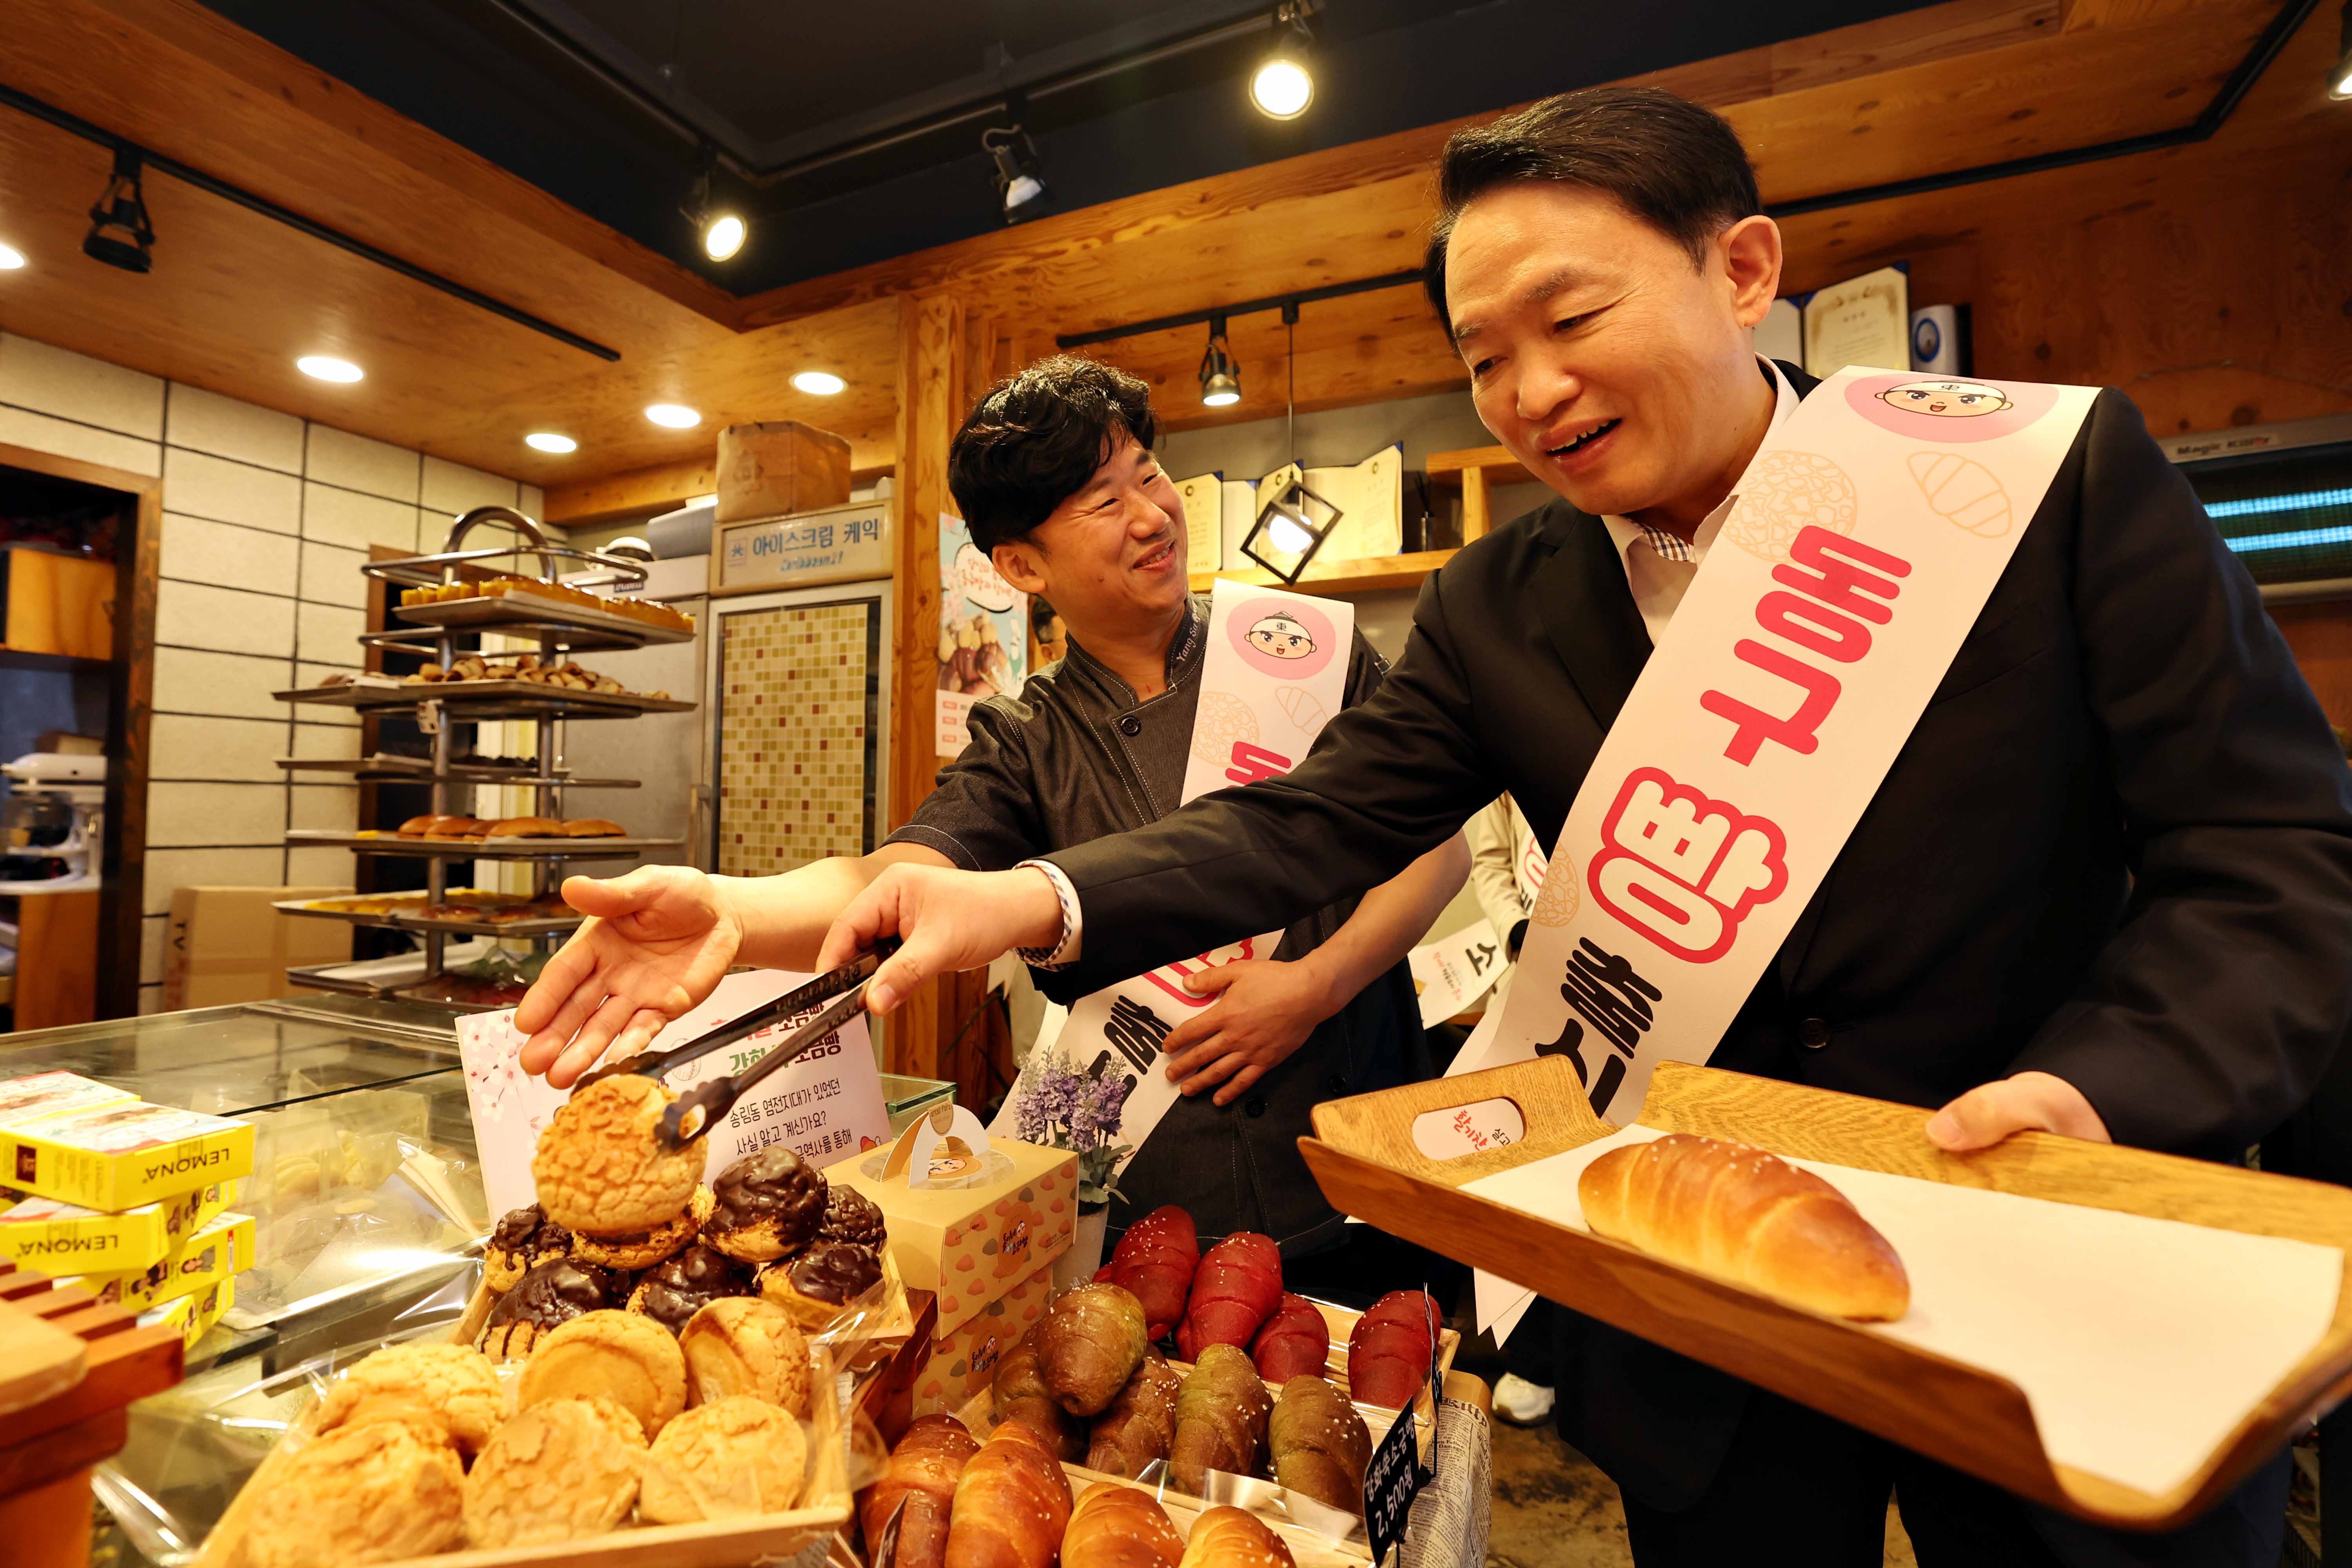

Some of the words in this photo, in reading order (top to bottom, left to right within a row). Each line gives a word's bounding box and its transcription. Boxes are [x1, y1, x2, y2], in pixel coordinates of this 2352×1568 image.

[752, 524, 833, 557] 아이스크림
[843, 518, 879, 544] 케익
[1276, 622, 1287, 632] 東
[1699, 524, 1912, 767] 동구
[1176, 637, 1196, 661] Yang
[1586, 766, 1789, 965] 빵
[730, 1102, 760, 1128] 송림동
[762, 1088, 811, 1117] 염전지대가
[813, 1078, 841, 1101] 있었던
[737, 1132, 759, 1156] 사실
[759, 1126, 782, 1148] 알고
[782, 1110, 826, 1138] 계신가요?
[833, 1128, 853, 1149] 통해
[1454, 1110, 1488, 1151] 활기찬
[145, 1147, 230, 1180] LEMONA
[19, 1235, 118, 1256] LEMONA
[1375, 1460, 1414, 1539] 2,500원
